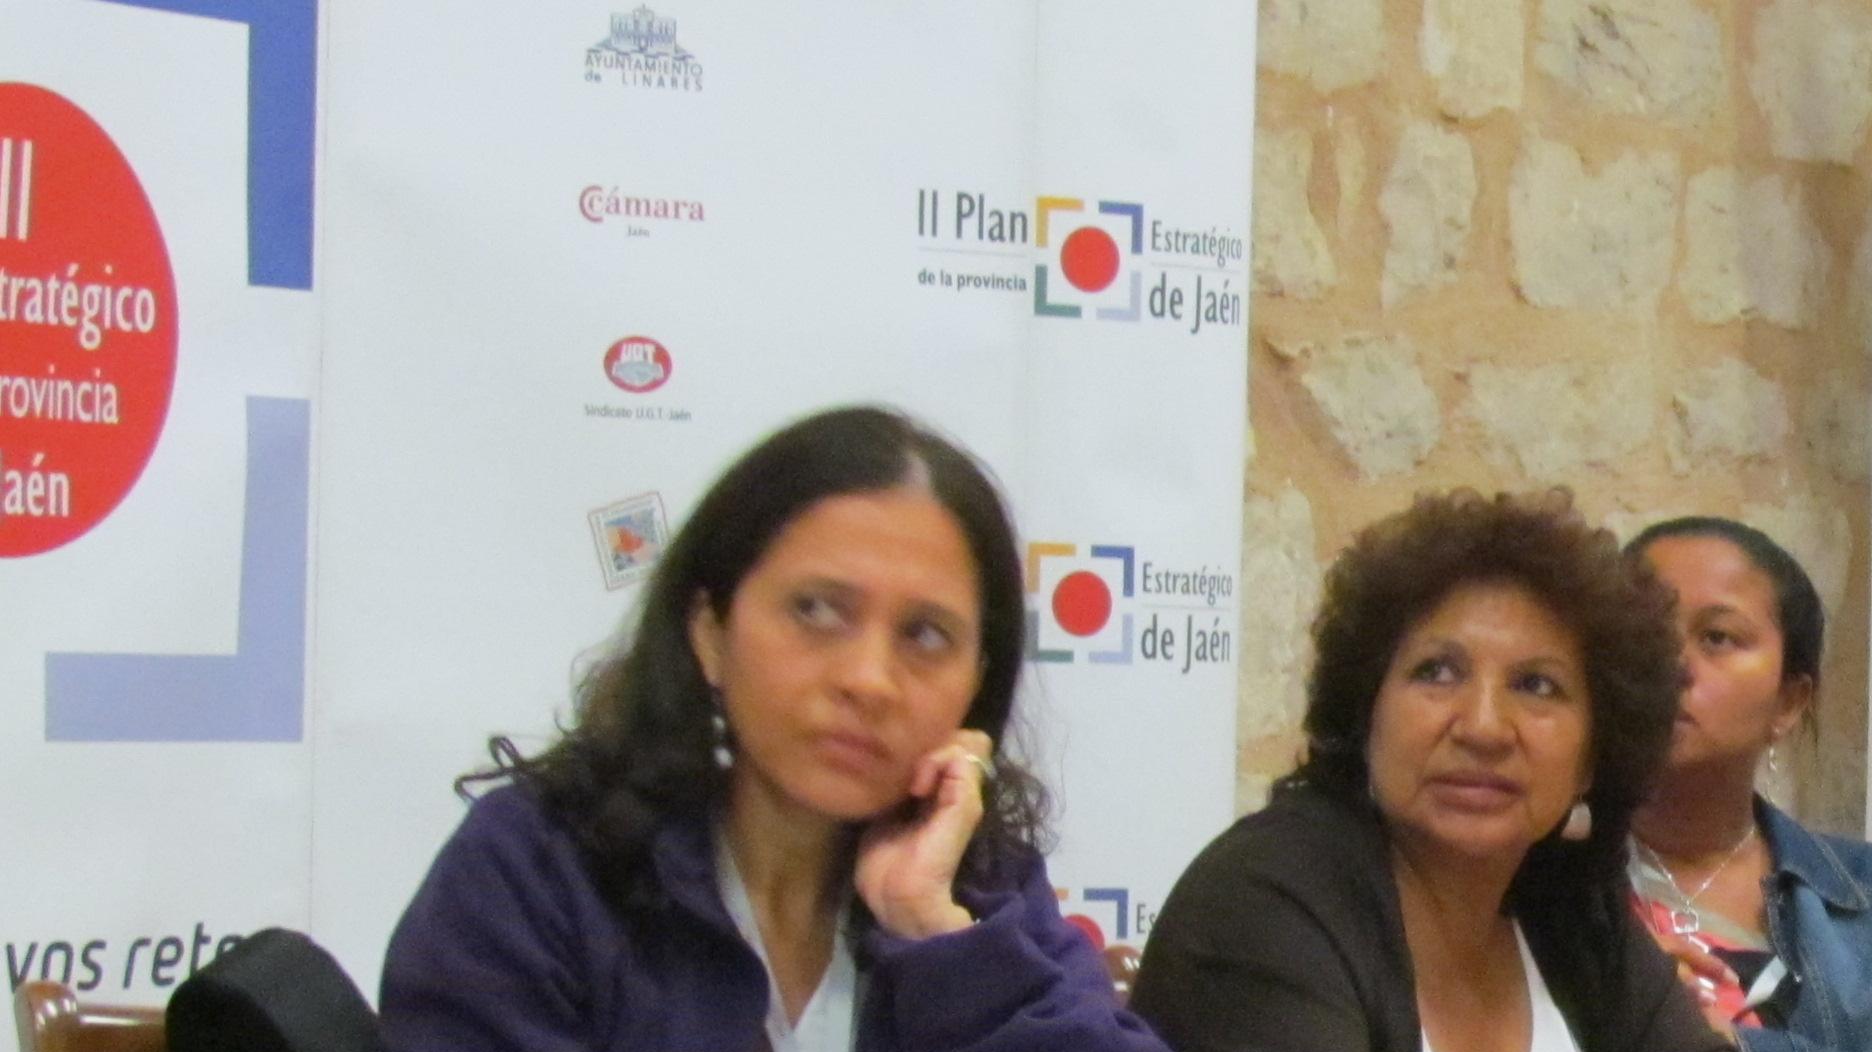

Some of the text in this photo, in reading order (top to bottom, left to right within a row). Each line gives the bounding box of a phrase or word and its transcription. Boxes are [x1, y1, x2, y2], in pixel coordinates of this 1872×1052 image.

[584, 70, 703, 92] de LINARES
[585, 53, 703, 76] AYUNTAMIENTO
[956, 191, 1028, 244] Plan
[1151, 220, 1243, 268] Estratégico
[918, 268, 1027, 292] de la provincia
[1150, 272, 1240, 334] de Jaén
[2, 453, 70, 517] aén
[1142, 561, 1232, 606] Estratégico
[1141, 613, 1231, 674] de Jaén
